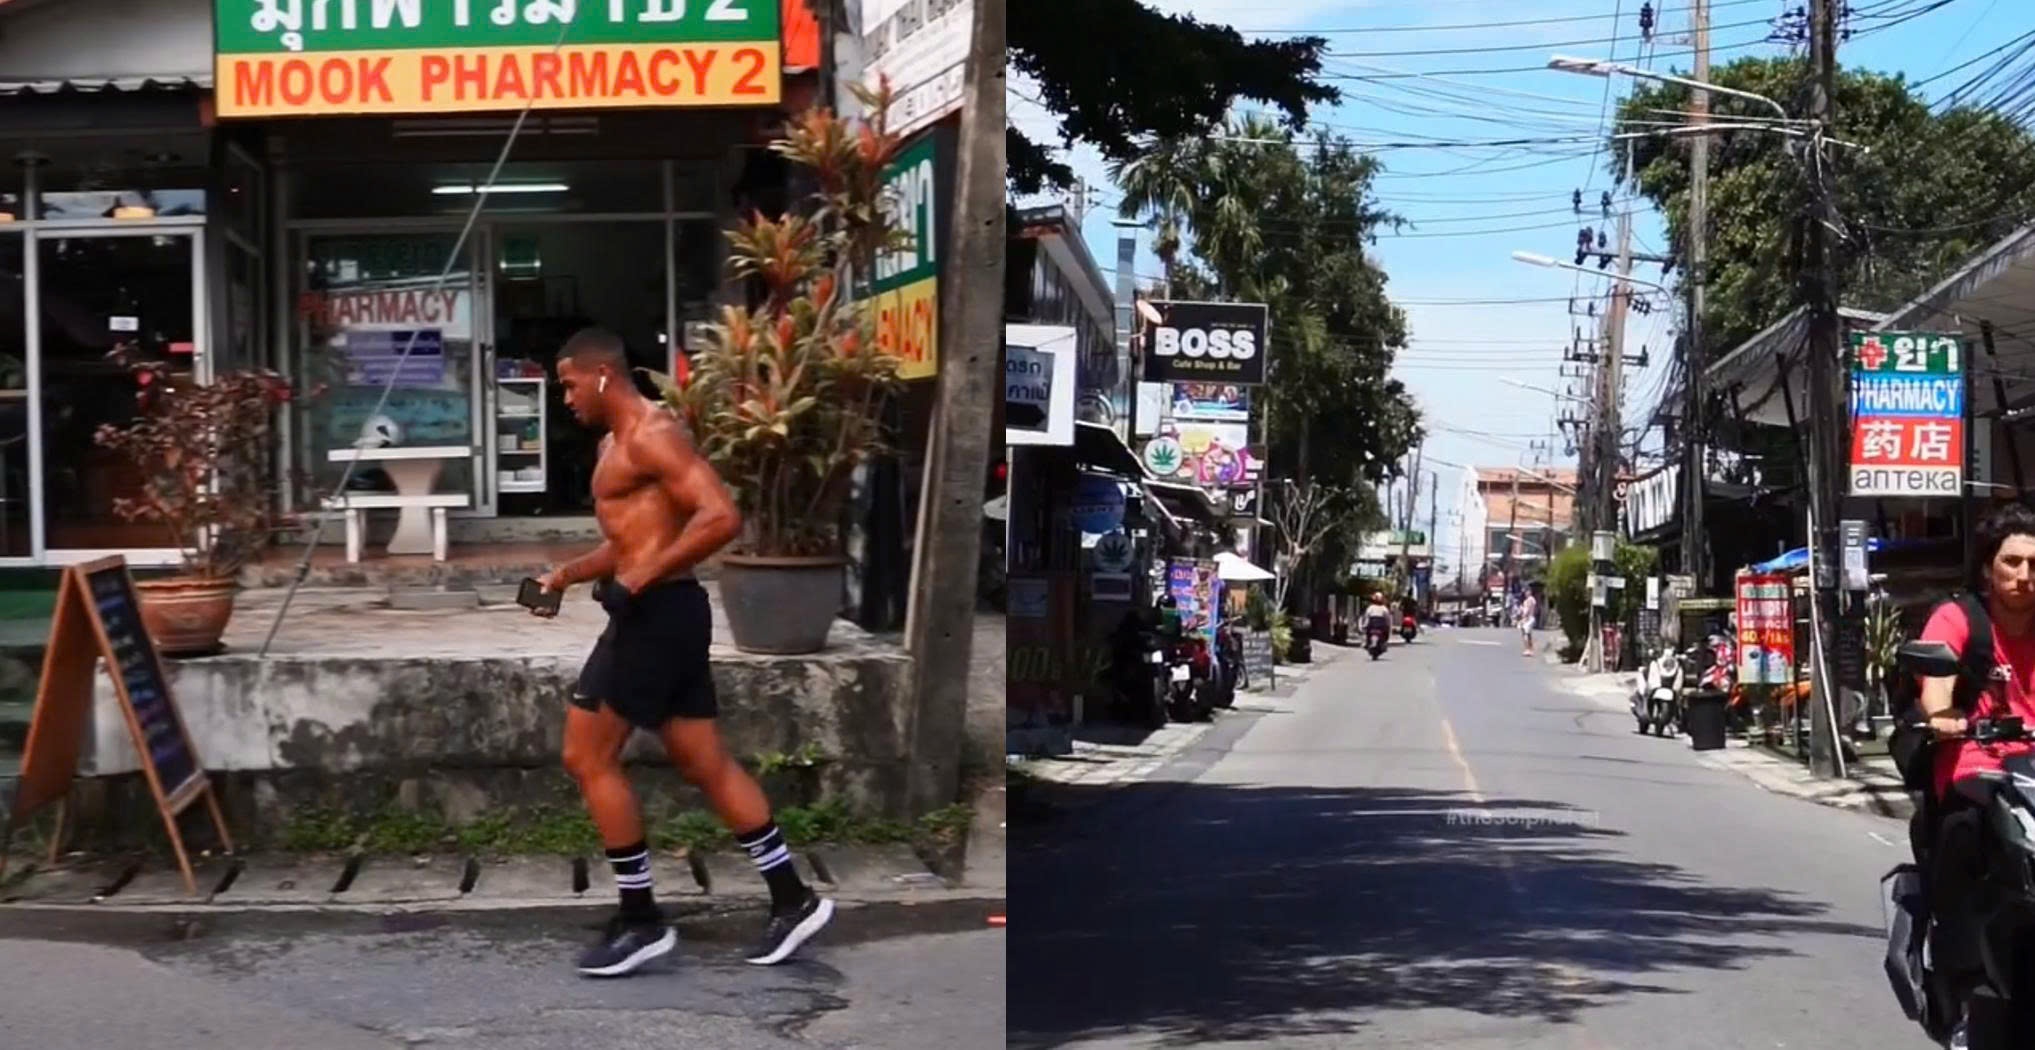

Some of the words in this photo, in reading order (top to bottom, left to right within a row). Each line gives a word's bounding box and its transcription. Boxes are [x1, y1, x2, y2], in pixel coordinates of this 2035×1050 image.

[234, 57, 394, 107] MOOK
[420, 49, 717, 102] PHARMACY
[731, 48, 767, 94] 2
[299, 289, 458, 325] PHARMACY
[1155, 327, 1255, 360] BOSS
[1893, 337, 1958, 371] ยา
[1852, 379, 1959, 411] PHARMACY
[1860, 420, 1953, 461] 药店
[1855, 469, 1957, 490] аптека
